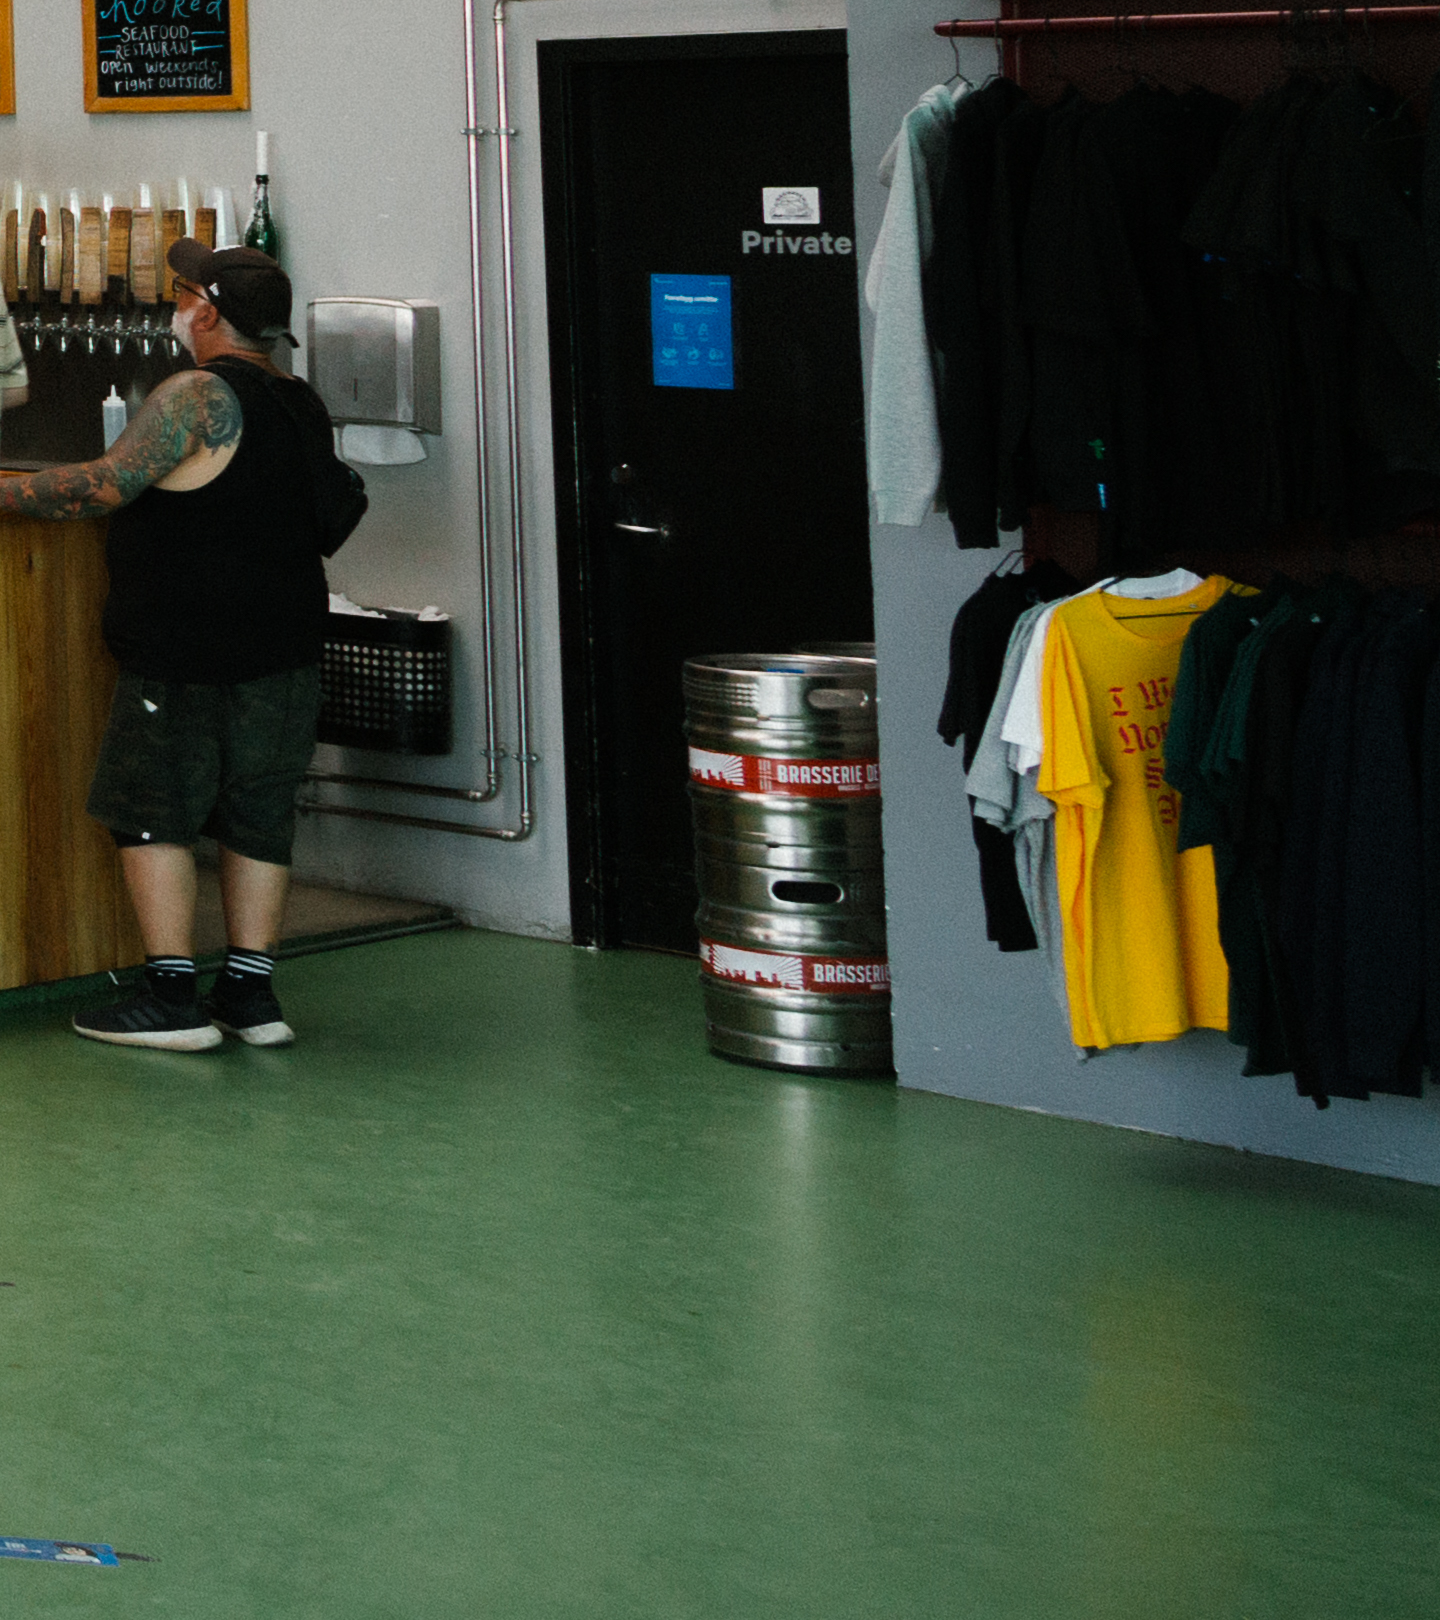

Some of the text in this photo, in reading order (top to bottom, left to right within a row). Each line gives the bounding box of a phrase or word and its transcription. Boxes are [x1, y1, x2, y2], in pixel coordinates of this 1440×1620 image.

[120, 24, 191, 42] SEAFOOD
[114, 40, 199, 60] RESTAURANT
[145, 58, 219, 74] weekends
[114, 72, 223, 93] right outside!
[741, 230, 853, 255] Private
[777, 764, 863, 784] BRASSERIE
